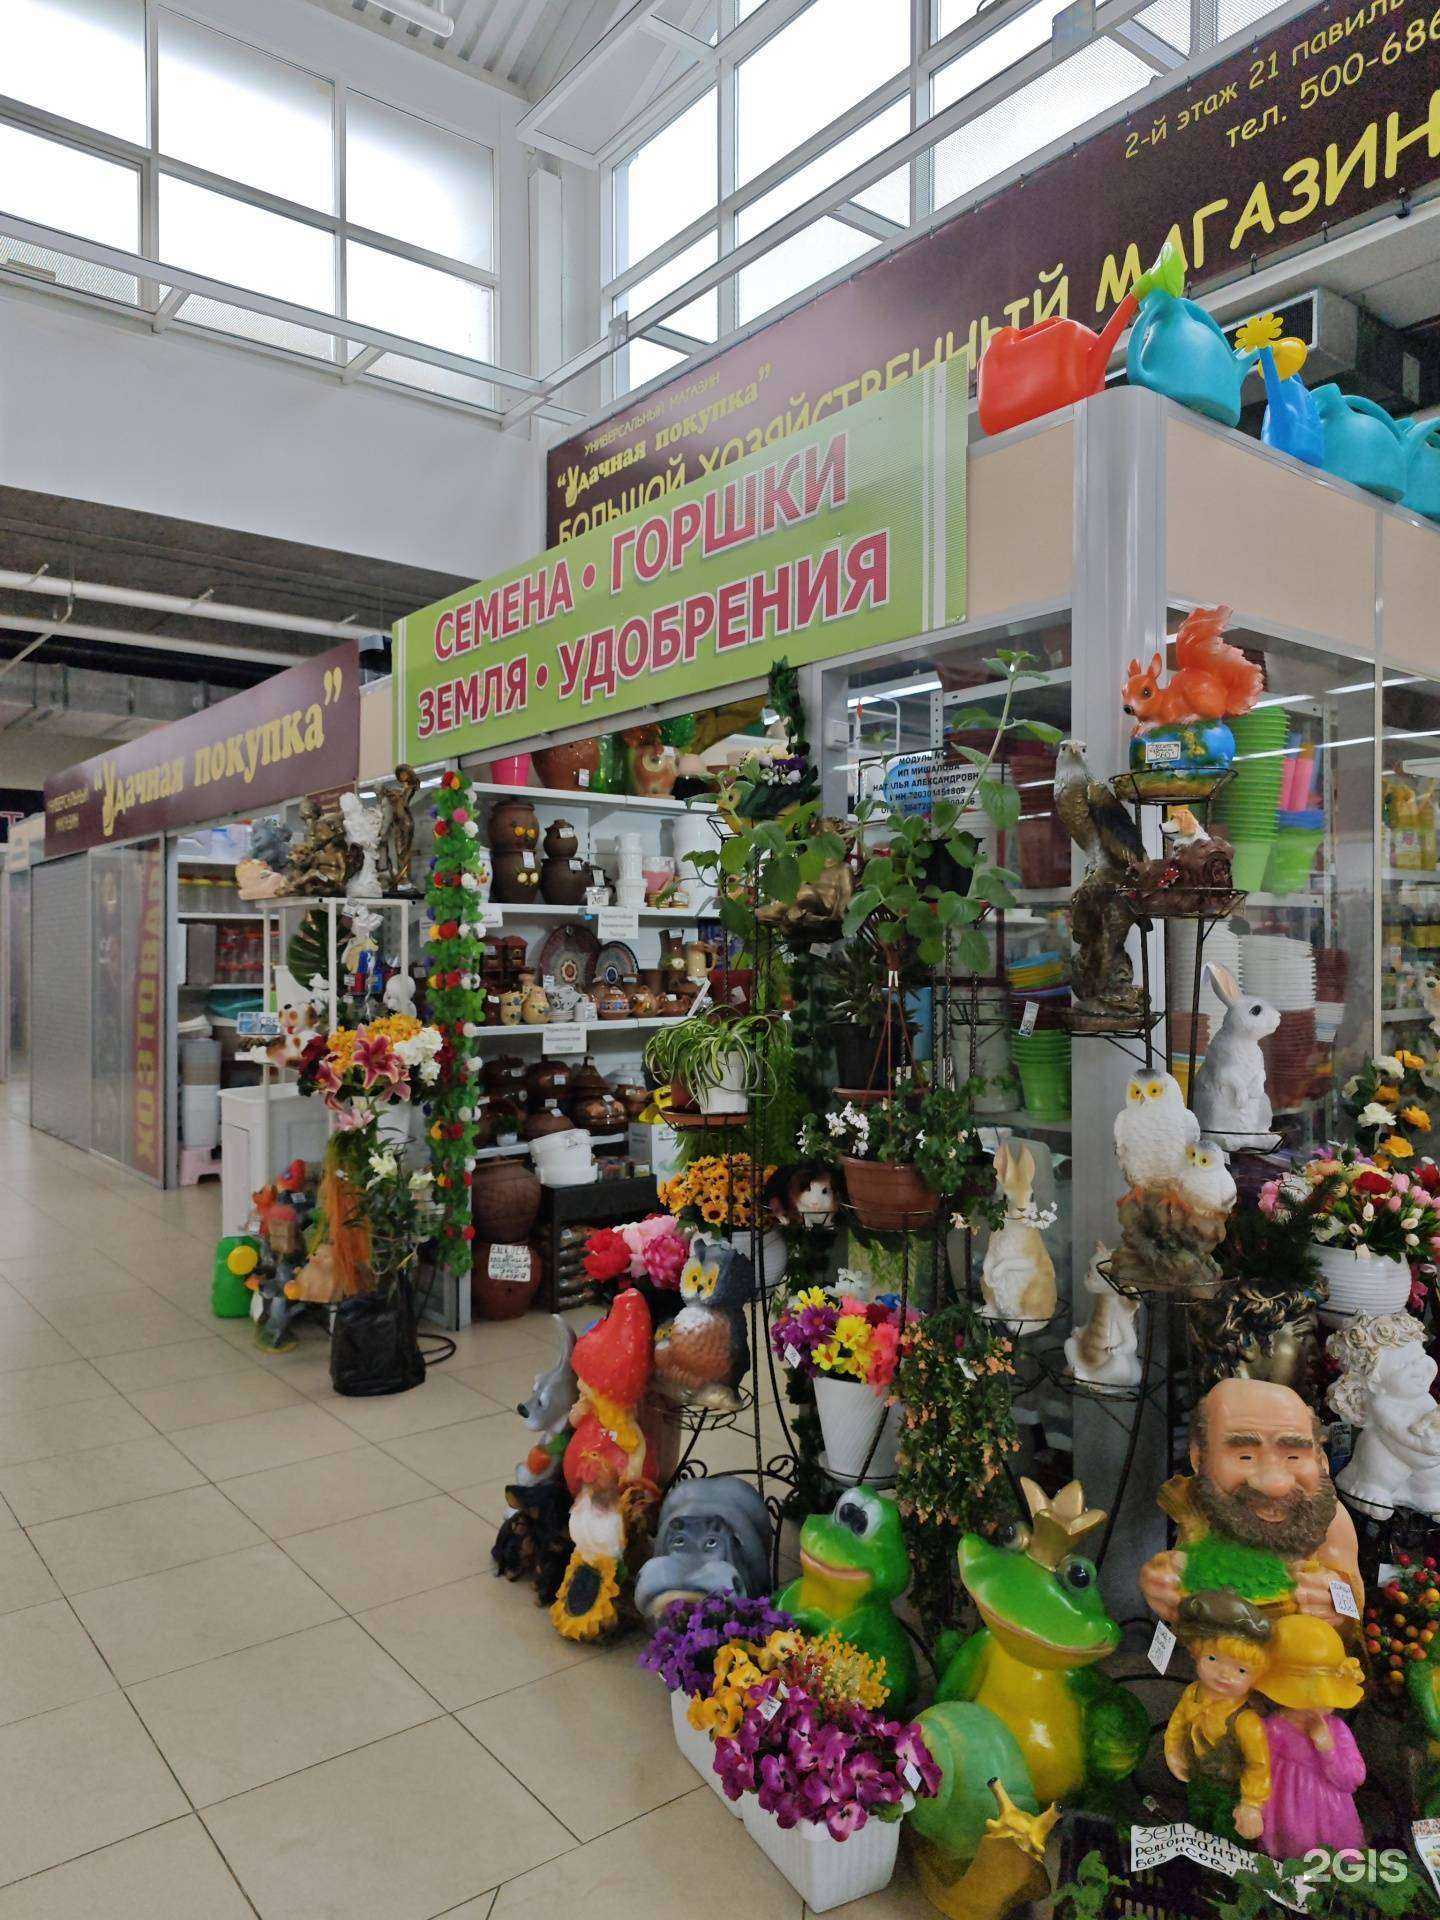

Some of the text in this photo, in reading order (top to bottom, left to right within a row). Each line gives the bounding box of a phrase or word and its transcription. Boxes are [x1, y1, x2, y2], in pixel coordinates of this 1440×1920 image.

[1125, 118, 1167, 159] 2-й
[1177, 82, 1238, 131] этаж
[1249, 52, 1279, 90] 21
[1225, 105, 1287, 148] тел.
[584, 371, 720, 456] УНИВЕРСАЛЬНЫЙ МАГАЗИН
[434, 431, 849, 662] СЕМЕНА ГОРШКИ
[417, 528, 890, 739] ЗЕМЛЯ УДОБРЕНИЯ
[898, 768, 909, 777] ИП
[912, 772, 980, 787] АЛЕКСАНДРОВН
